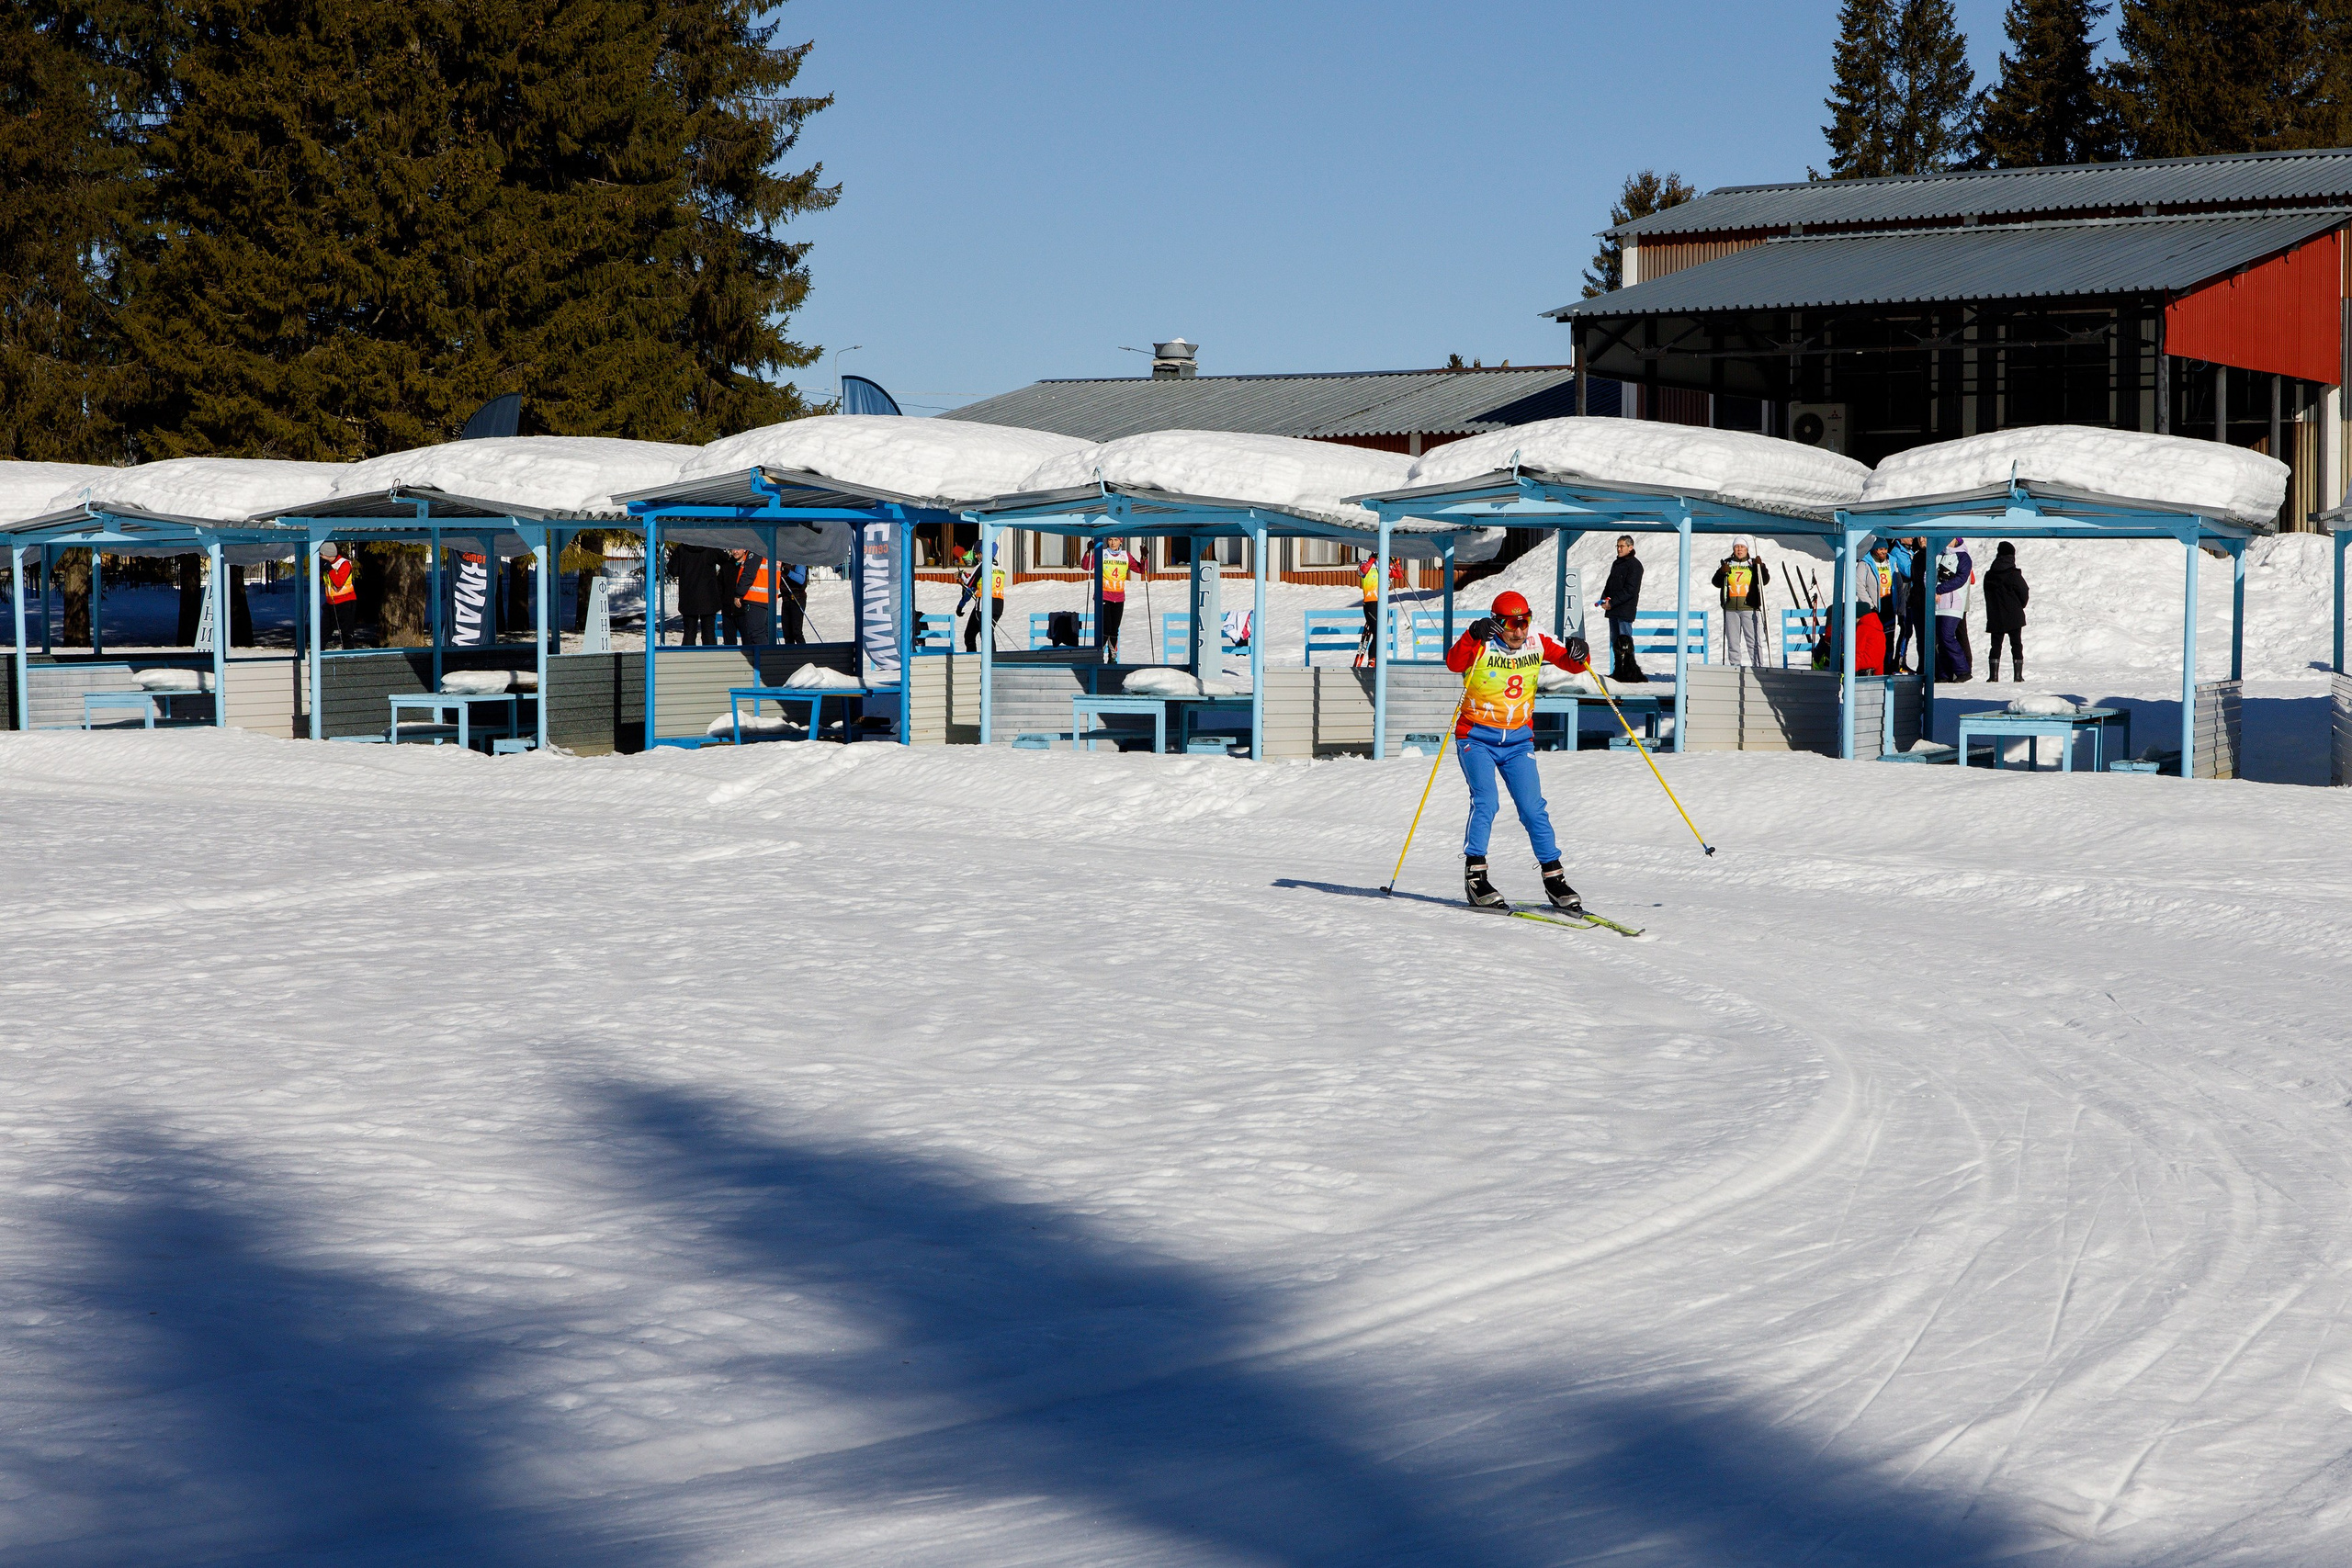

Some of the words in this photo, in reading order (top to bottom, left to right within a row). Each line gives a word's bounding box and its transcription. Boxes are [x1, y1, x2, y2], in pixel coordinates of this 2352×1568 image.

[1112, 567, 1119, 579] 4
[1736, 571, 1744, 582] 7
[1880, 573, 1888, 584] 8
[995, 576, 1001, 588] 9
[1487, 653, 1540, 670] AKKERMANN
[1504, 674, 1523, 699] 8
